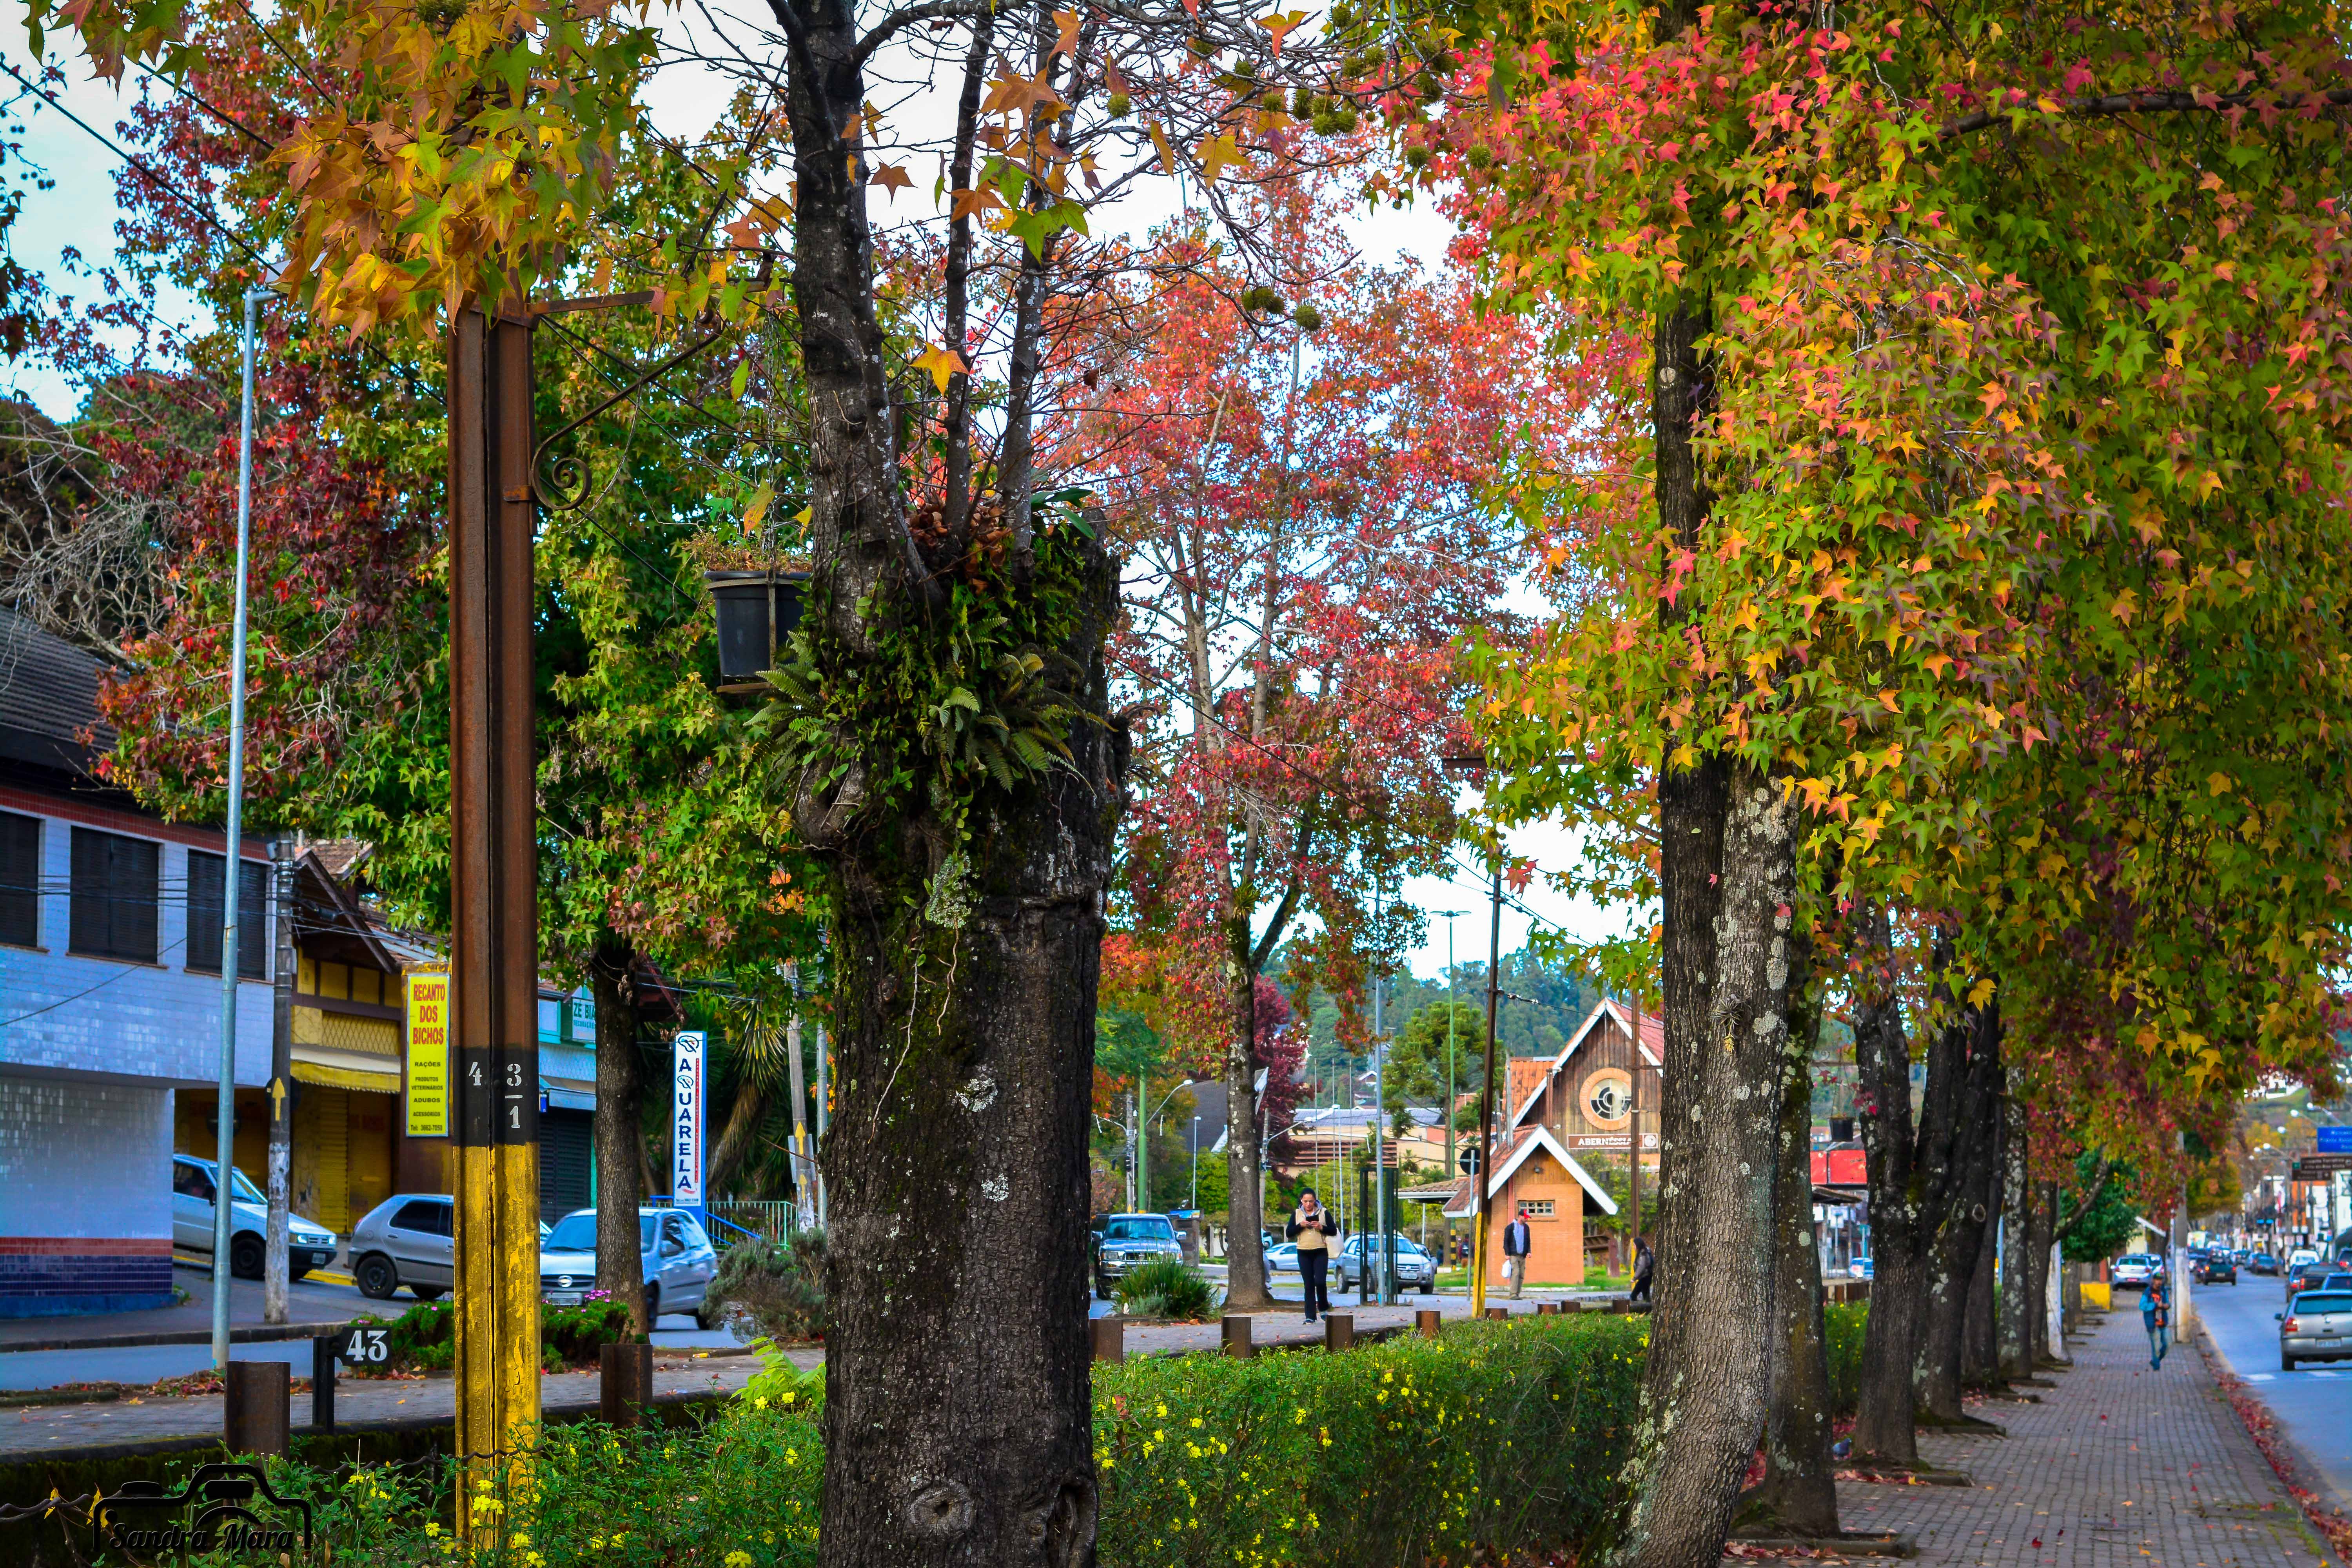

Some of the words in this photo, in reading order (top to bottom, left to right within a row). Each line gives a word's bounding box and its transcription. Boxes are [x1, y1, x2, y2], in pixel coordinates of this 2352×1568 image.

[414, 984, 445, 1001] RECANTO
[420, 1005, 438, 1023] DOS
[573, 1000, 582, 1018] ZÉ
[413, 1027, 444, 1045] BICHOS
[510, 1106, 520, 1128] 1
[346, 1330, 387, 1361] 43
